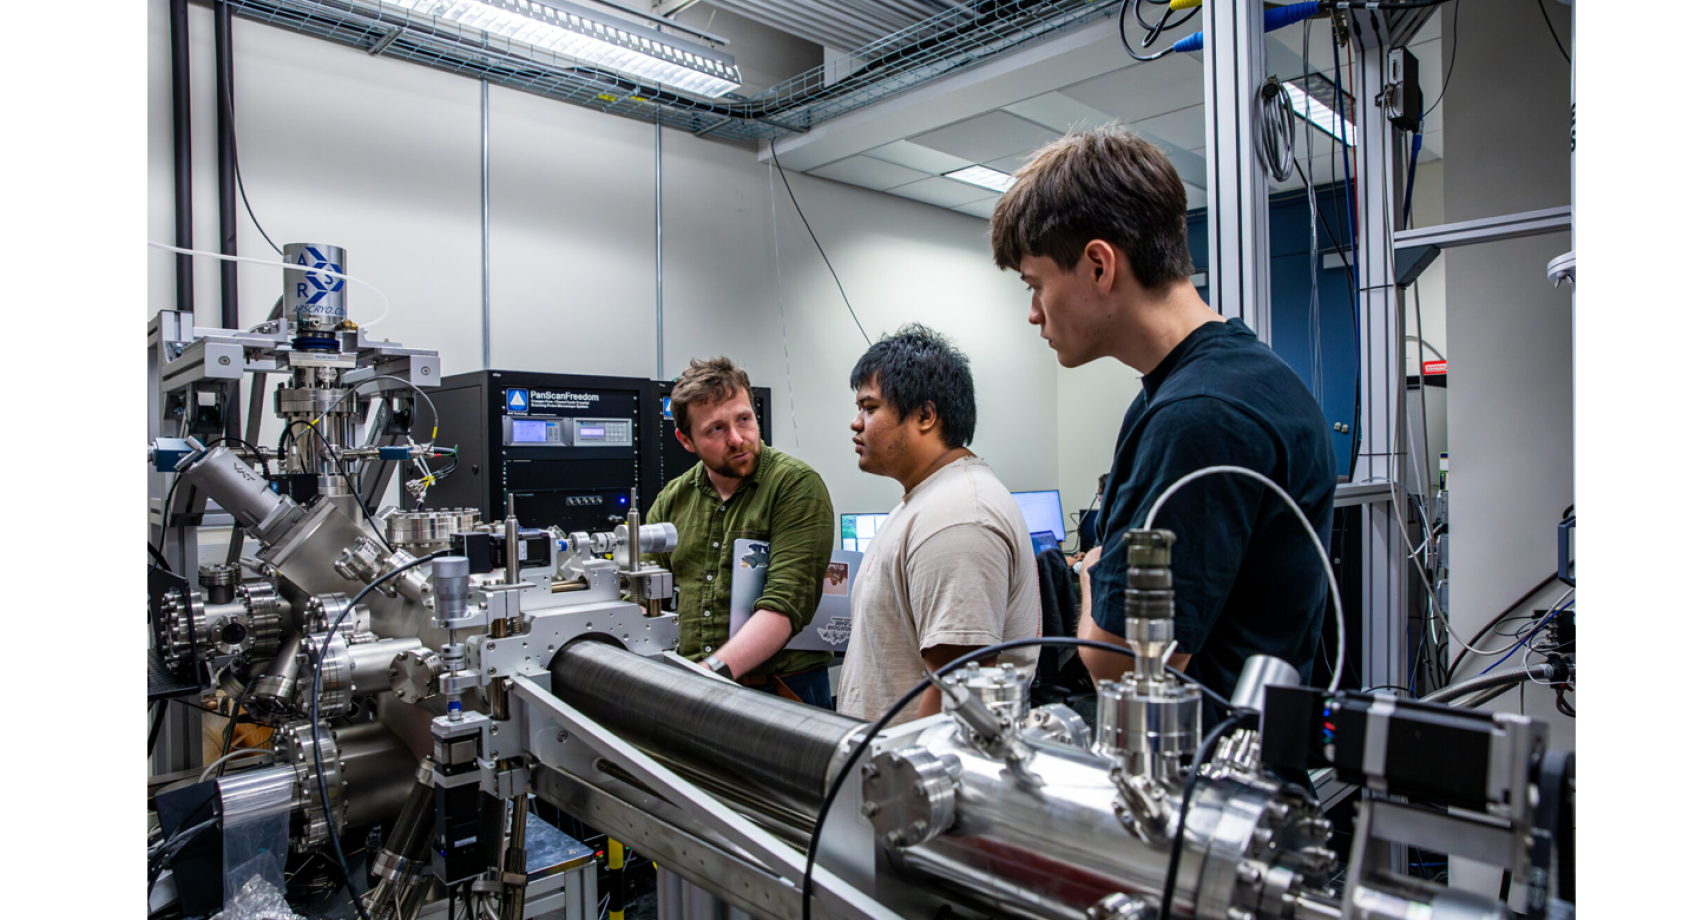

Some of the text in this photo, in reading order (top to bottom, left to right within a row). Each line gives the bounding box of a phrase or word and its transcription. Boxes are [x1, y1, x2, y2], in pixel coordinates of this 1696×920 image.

[297, 253, 308, 266] A
[297, 282, 309, 298] R
[530, 390, 599, 401] PanScanFreedom
